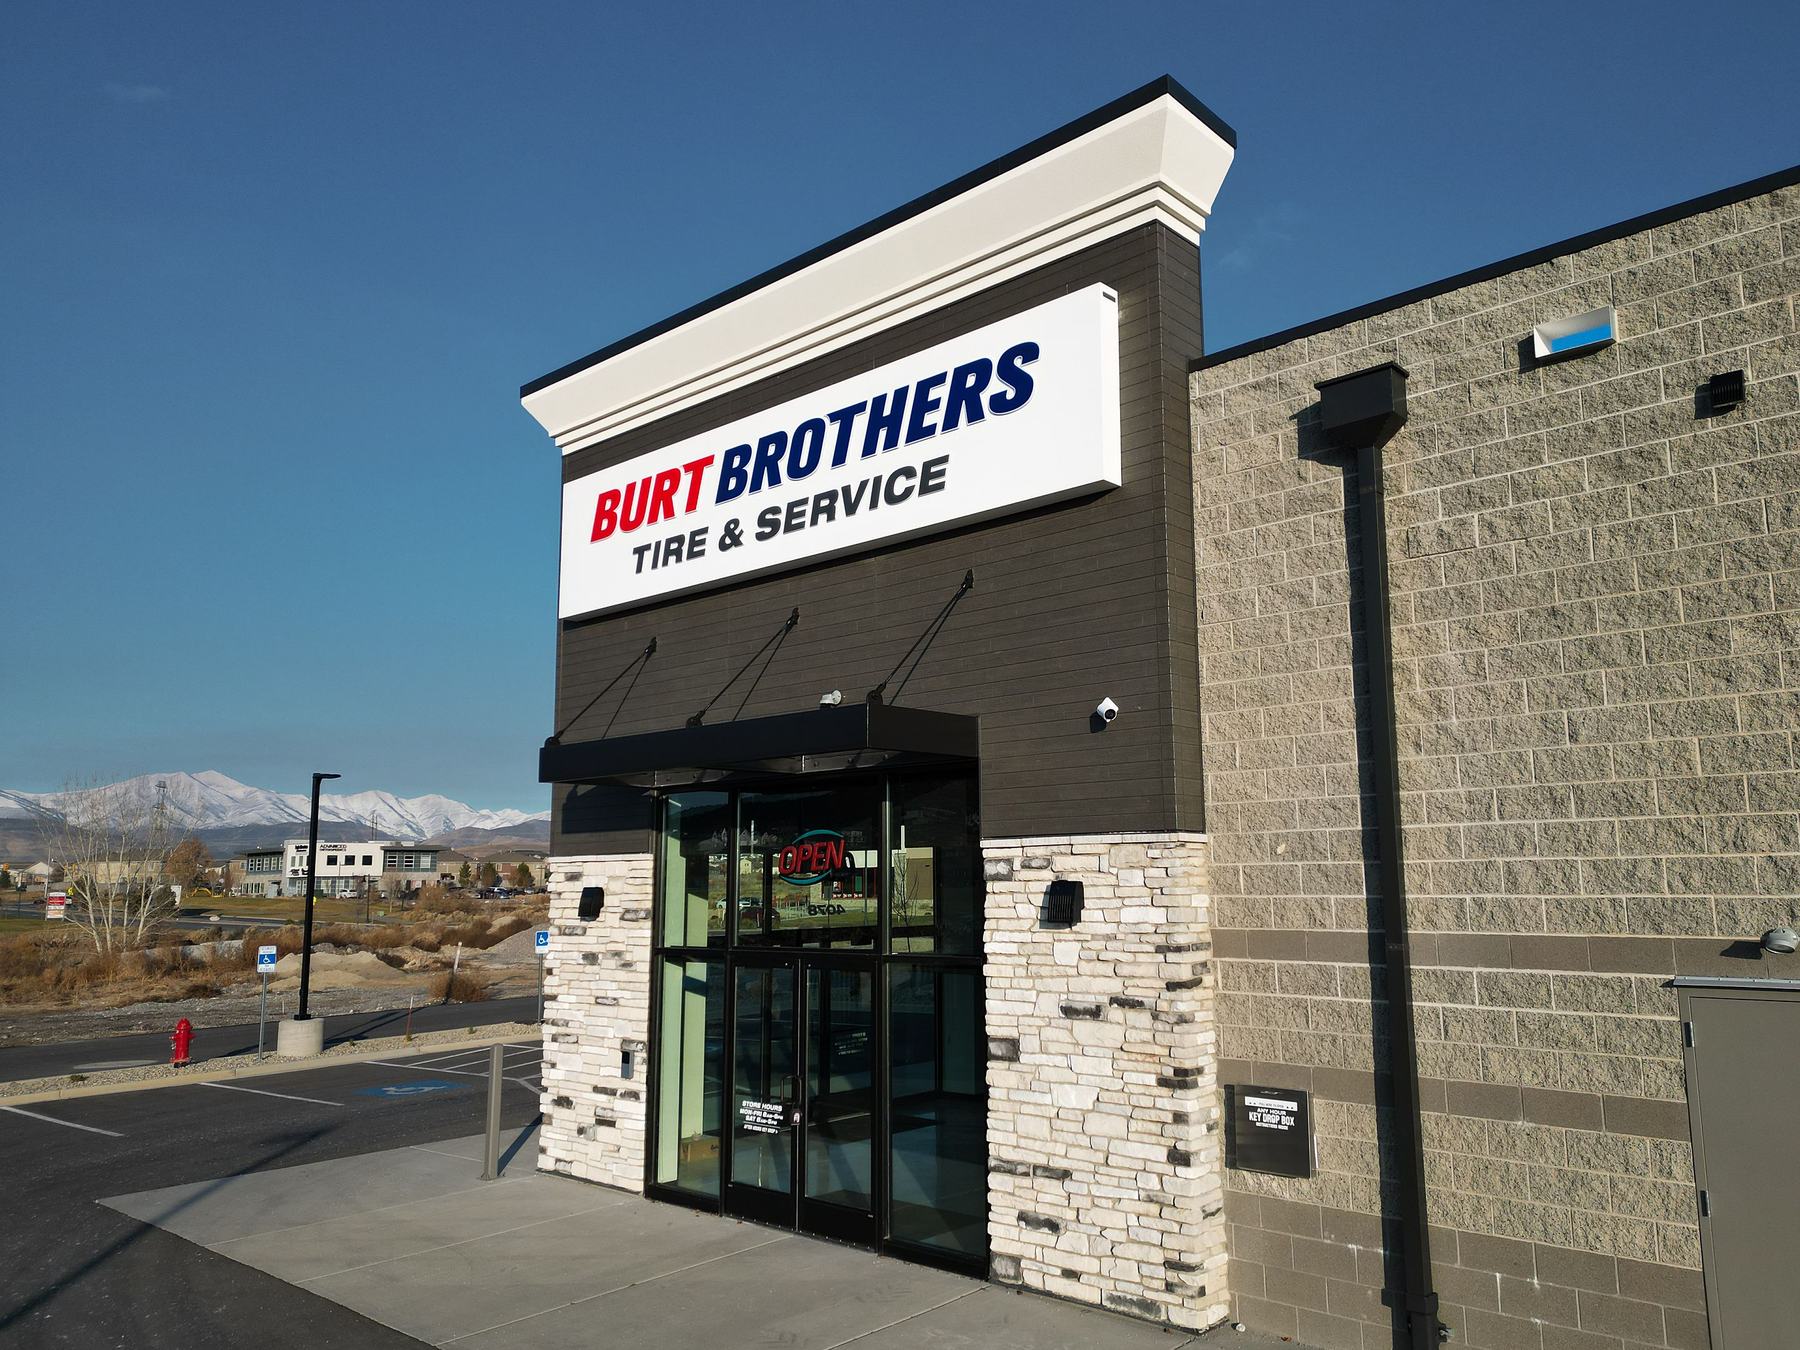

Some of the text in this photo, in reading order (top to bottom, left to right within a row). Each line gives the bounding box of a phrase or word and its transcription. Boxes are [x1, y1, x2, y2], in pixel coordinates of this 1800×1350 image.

[590, 341, 1040, 543] BURT BROTHERS
[632, 454, 950, 575] TIRE & SERVICE
[778, 839, 846, 875] OPEN
[742, 1100, 782, 1111] STORE HOURS
[1249, 1111, 1261, 1121] KEY
[1262, 1114, 1280, 1123] DROP
[1281, 1116, 1295, 1126] BOX
